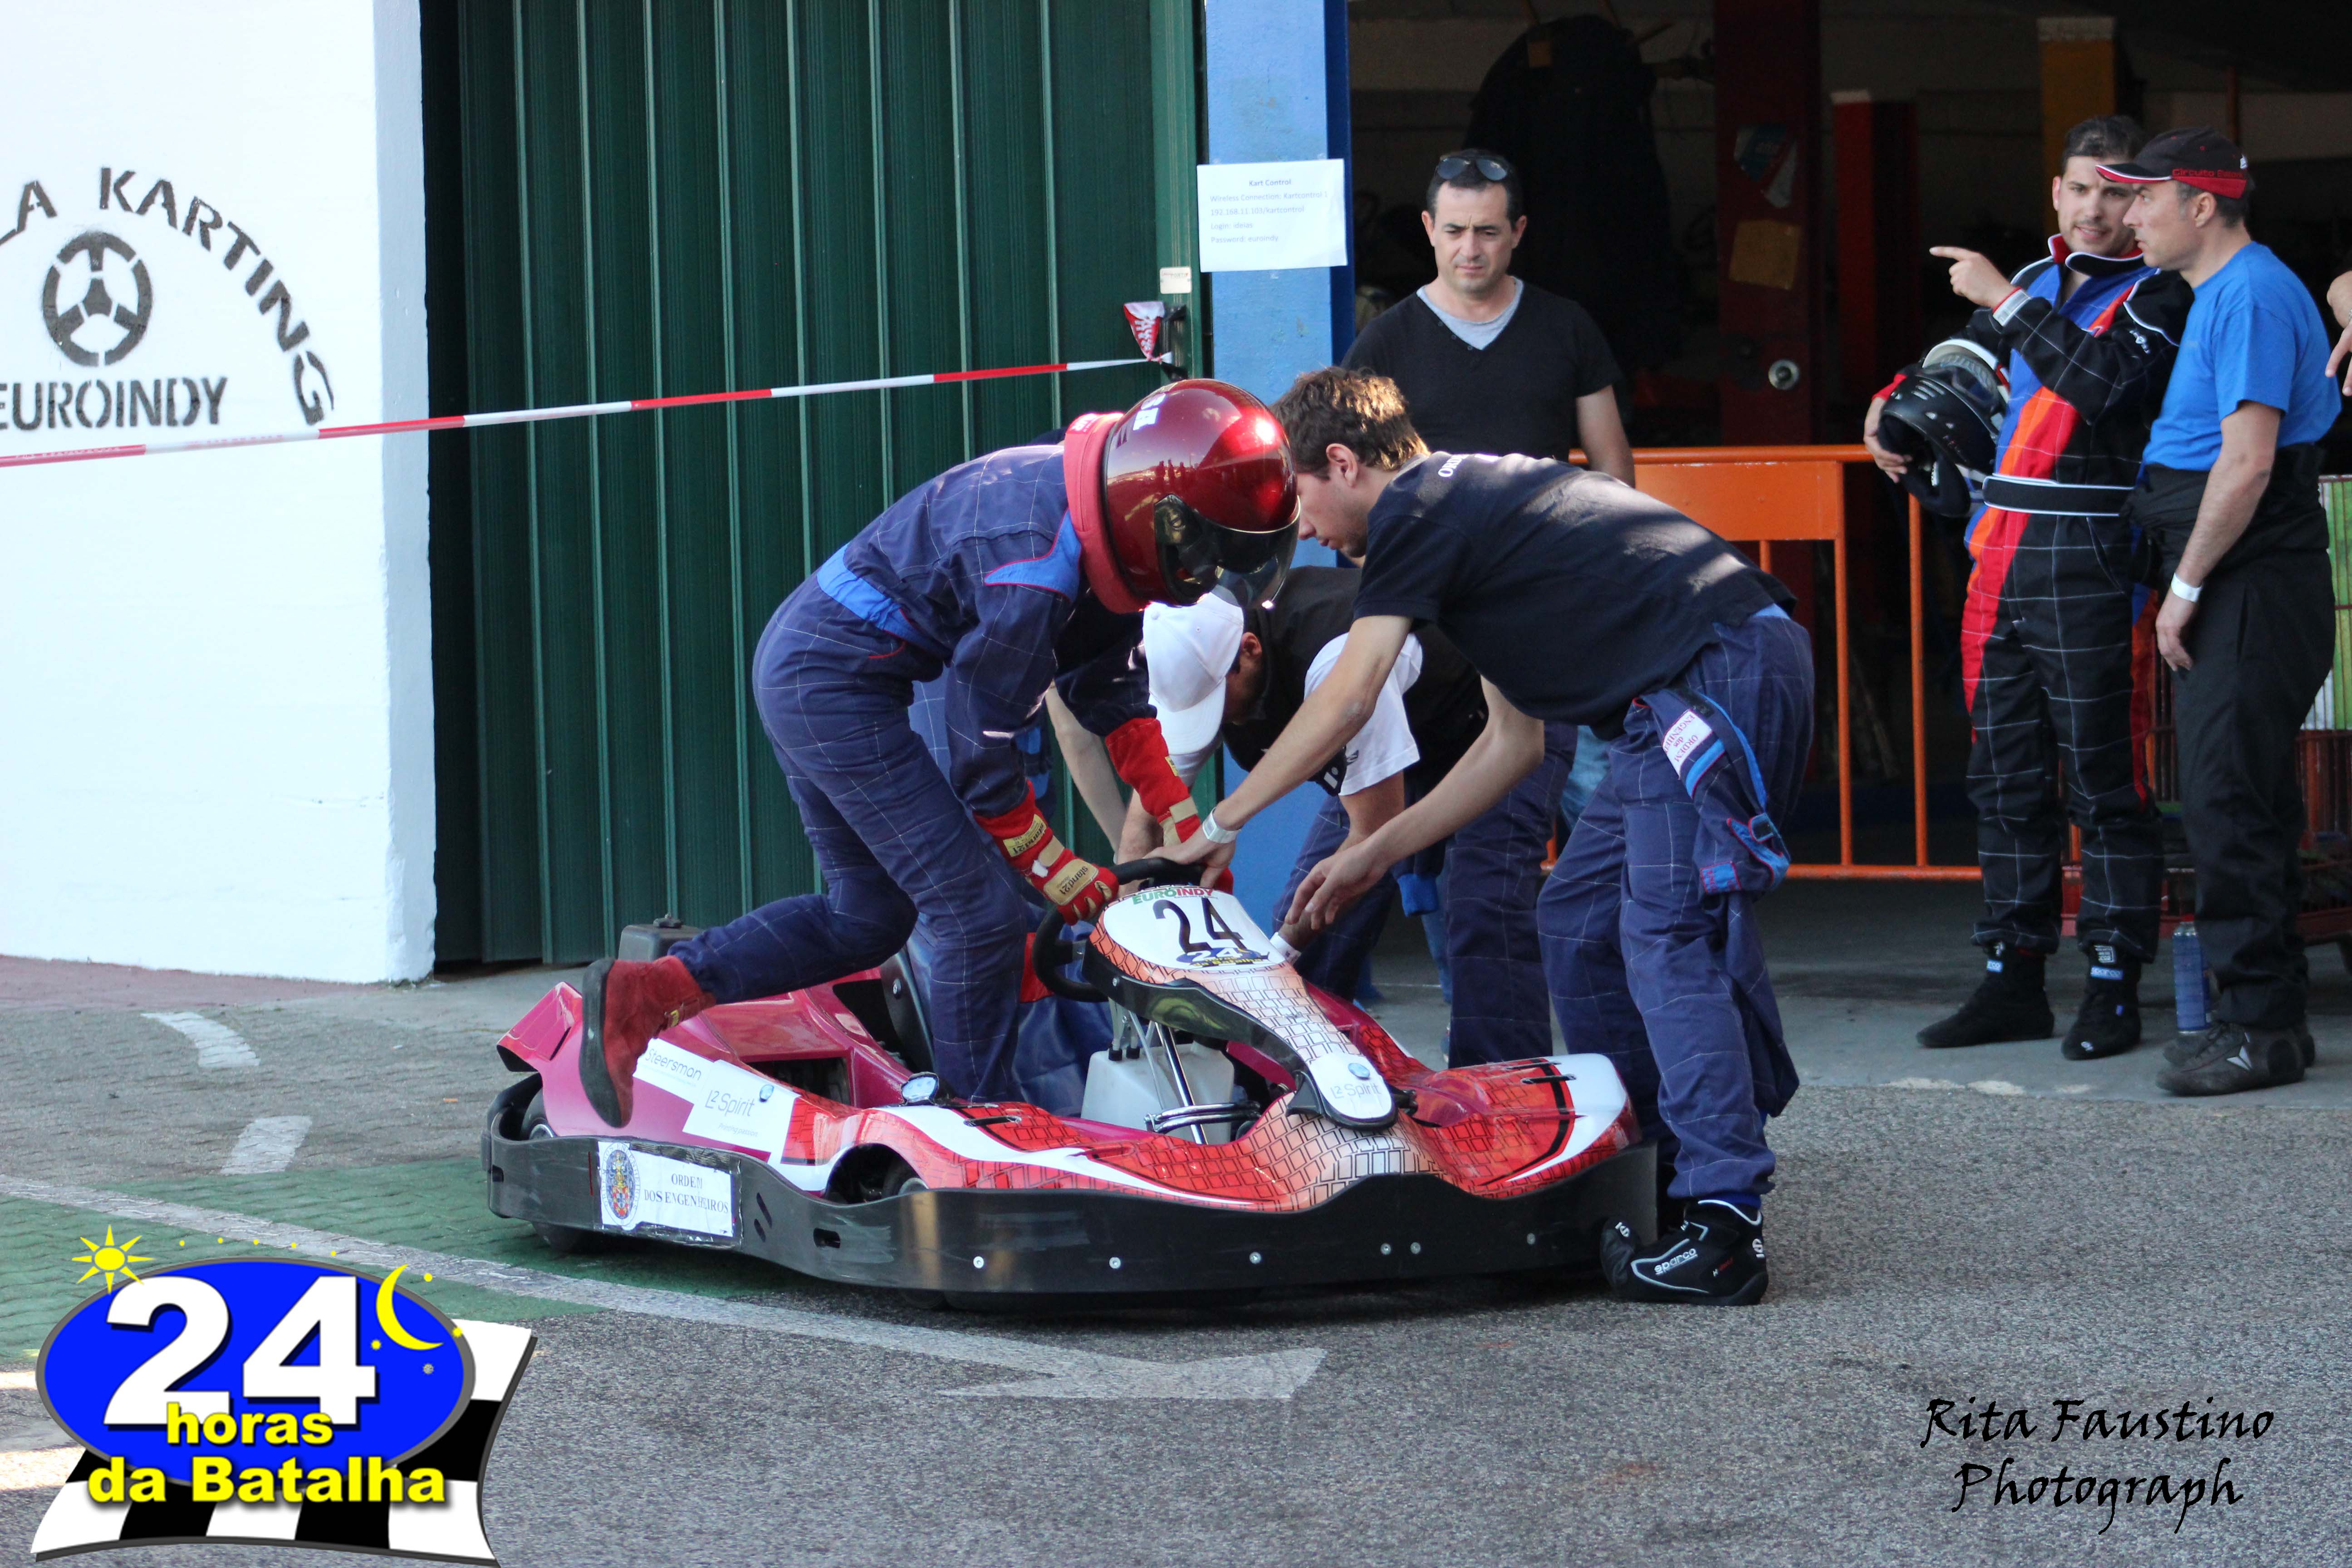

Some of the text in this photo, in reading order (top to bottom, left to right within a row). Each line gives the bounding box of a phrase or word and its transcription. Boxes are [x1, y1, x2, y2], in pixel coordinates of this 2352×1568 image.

[2172, 168, 2215, 176] Circuito
[1284, 191, 1322, 200] Kartcontrol
[1210, 222, 1231, 230] Login:
[1248, 235, 1278, 244] euroindy
[99, 167, 334, 426] KARTING
[1152, 897, 1246, 951] 24
[1187, 948, 1243, 961] 24
[644, 1048, 702, 1081] Steersman
[671, 1172, 703, 1189] ORDEM
[644, 1189, 729, 1214] DOS ENGENHEIROS
[1654, 1248, 1697, 1275] sparco
